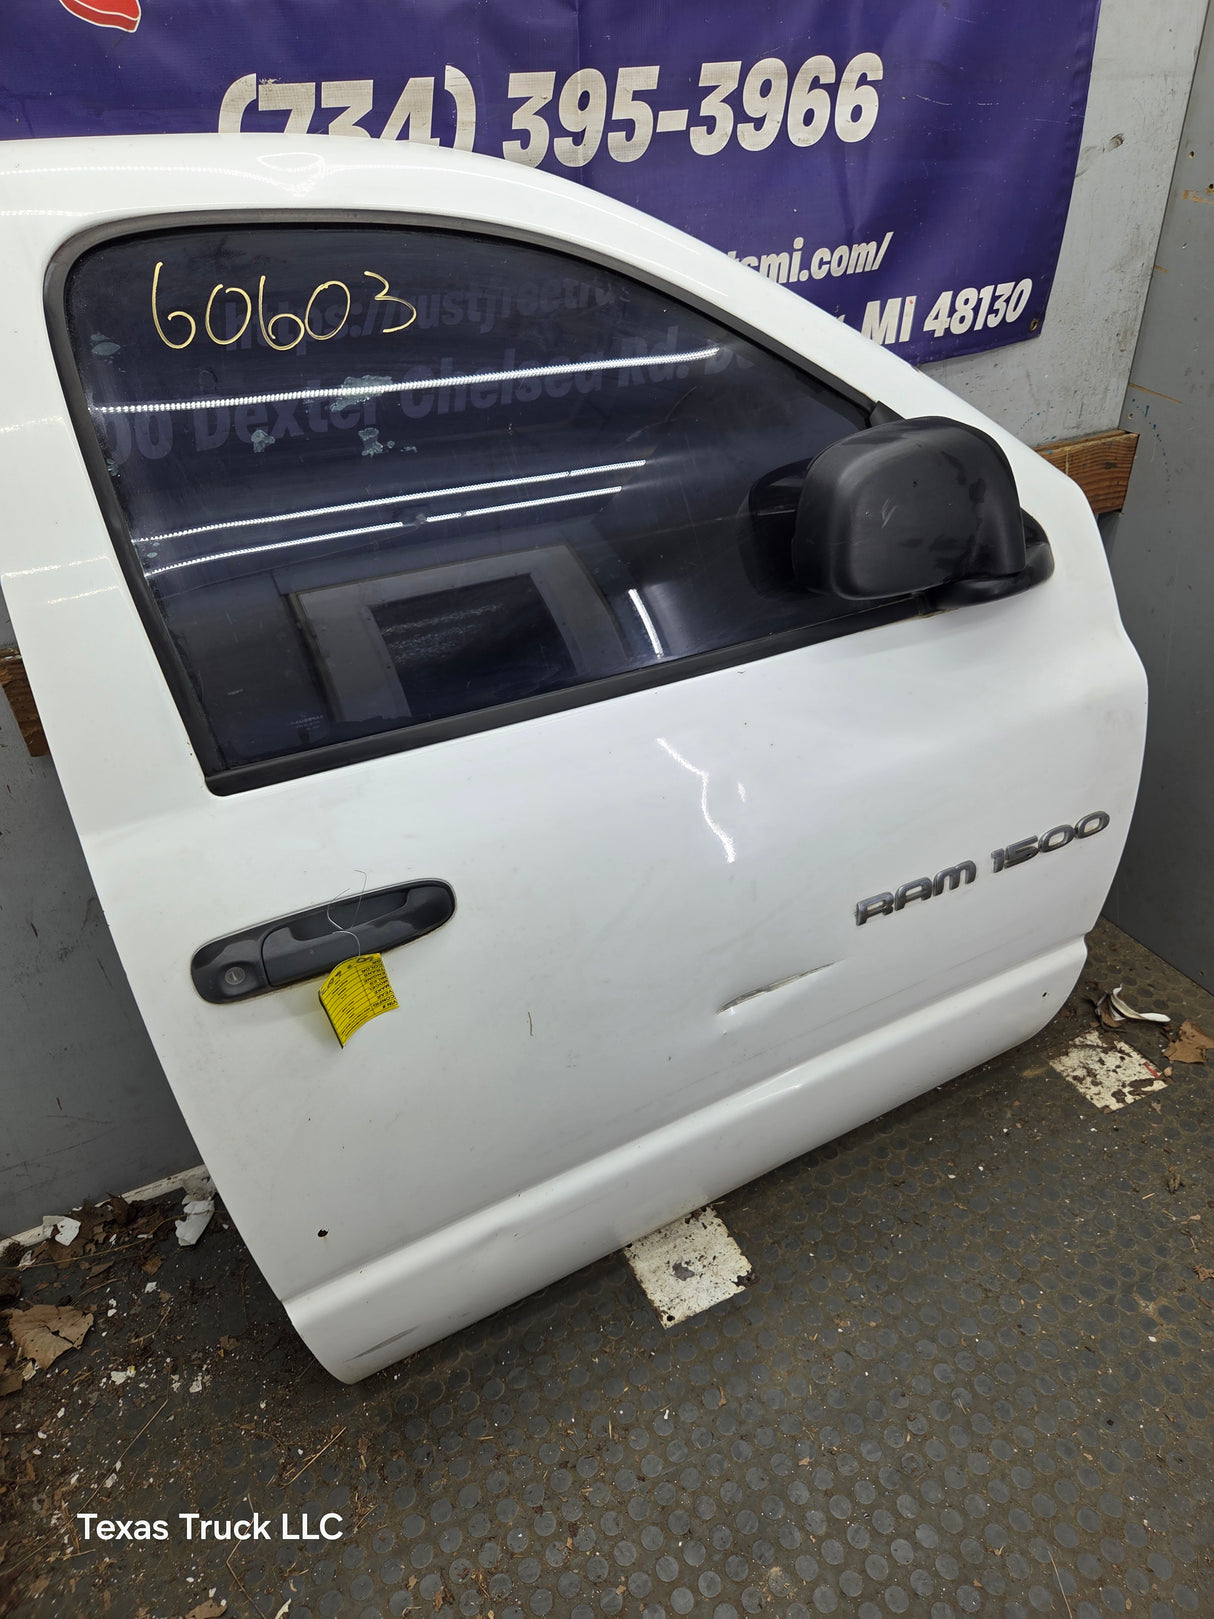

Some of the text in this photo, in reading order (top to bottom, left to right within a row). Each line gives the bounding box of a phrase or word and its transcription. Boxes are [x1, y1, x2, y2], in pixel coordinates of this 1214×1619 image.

[218, 52, 884, 168] (734) 395-3966
[727, 231, 894, 285] mi.com/
[151, 260, 417, 350] 60603
[861, 295, 917, 345] MI
[922, 277, 1033, 338] 48130
[854, 810, 1111, 927] RAM 1500
